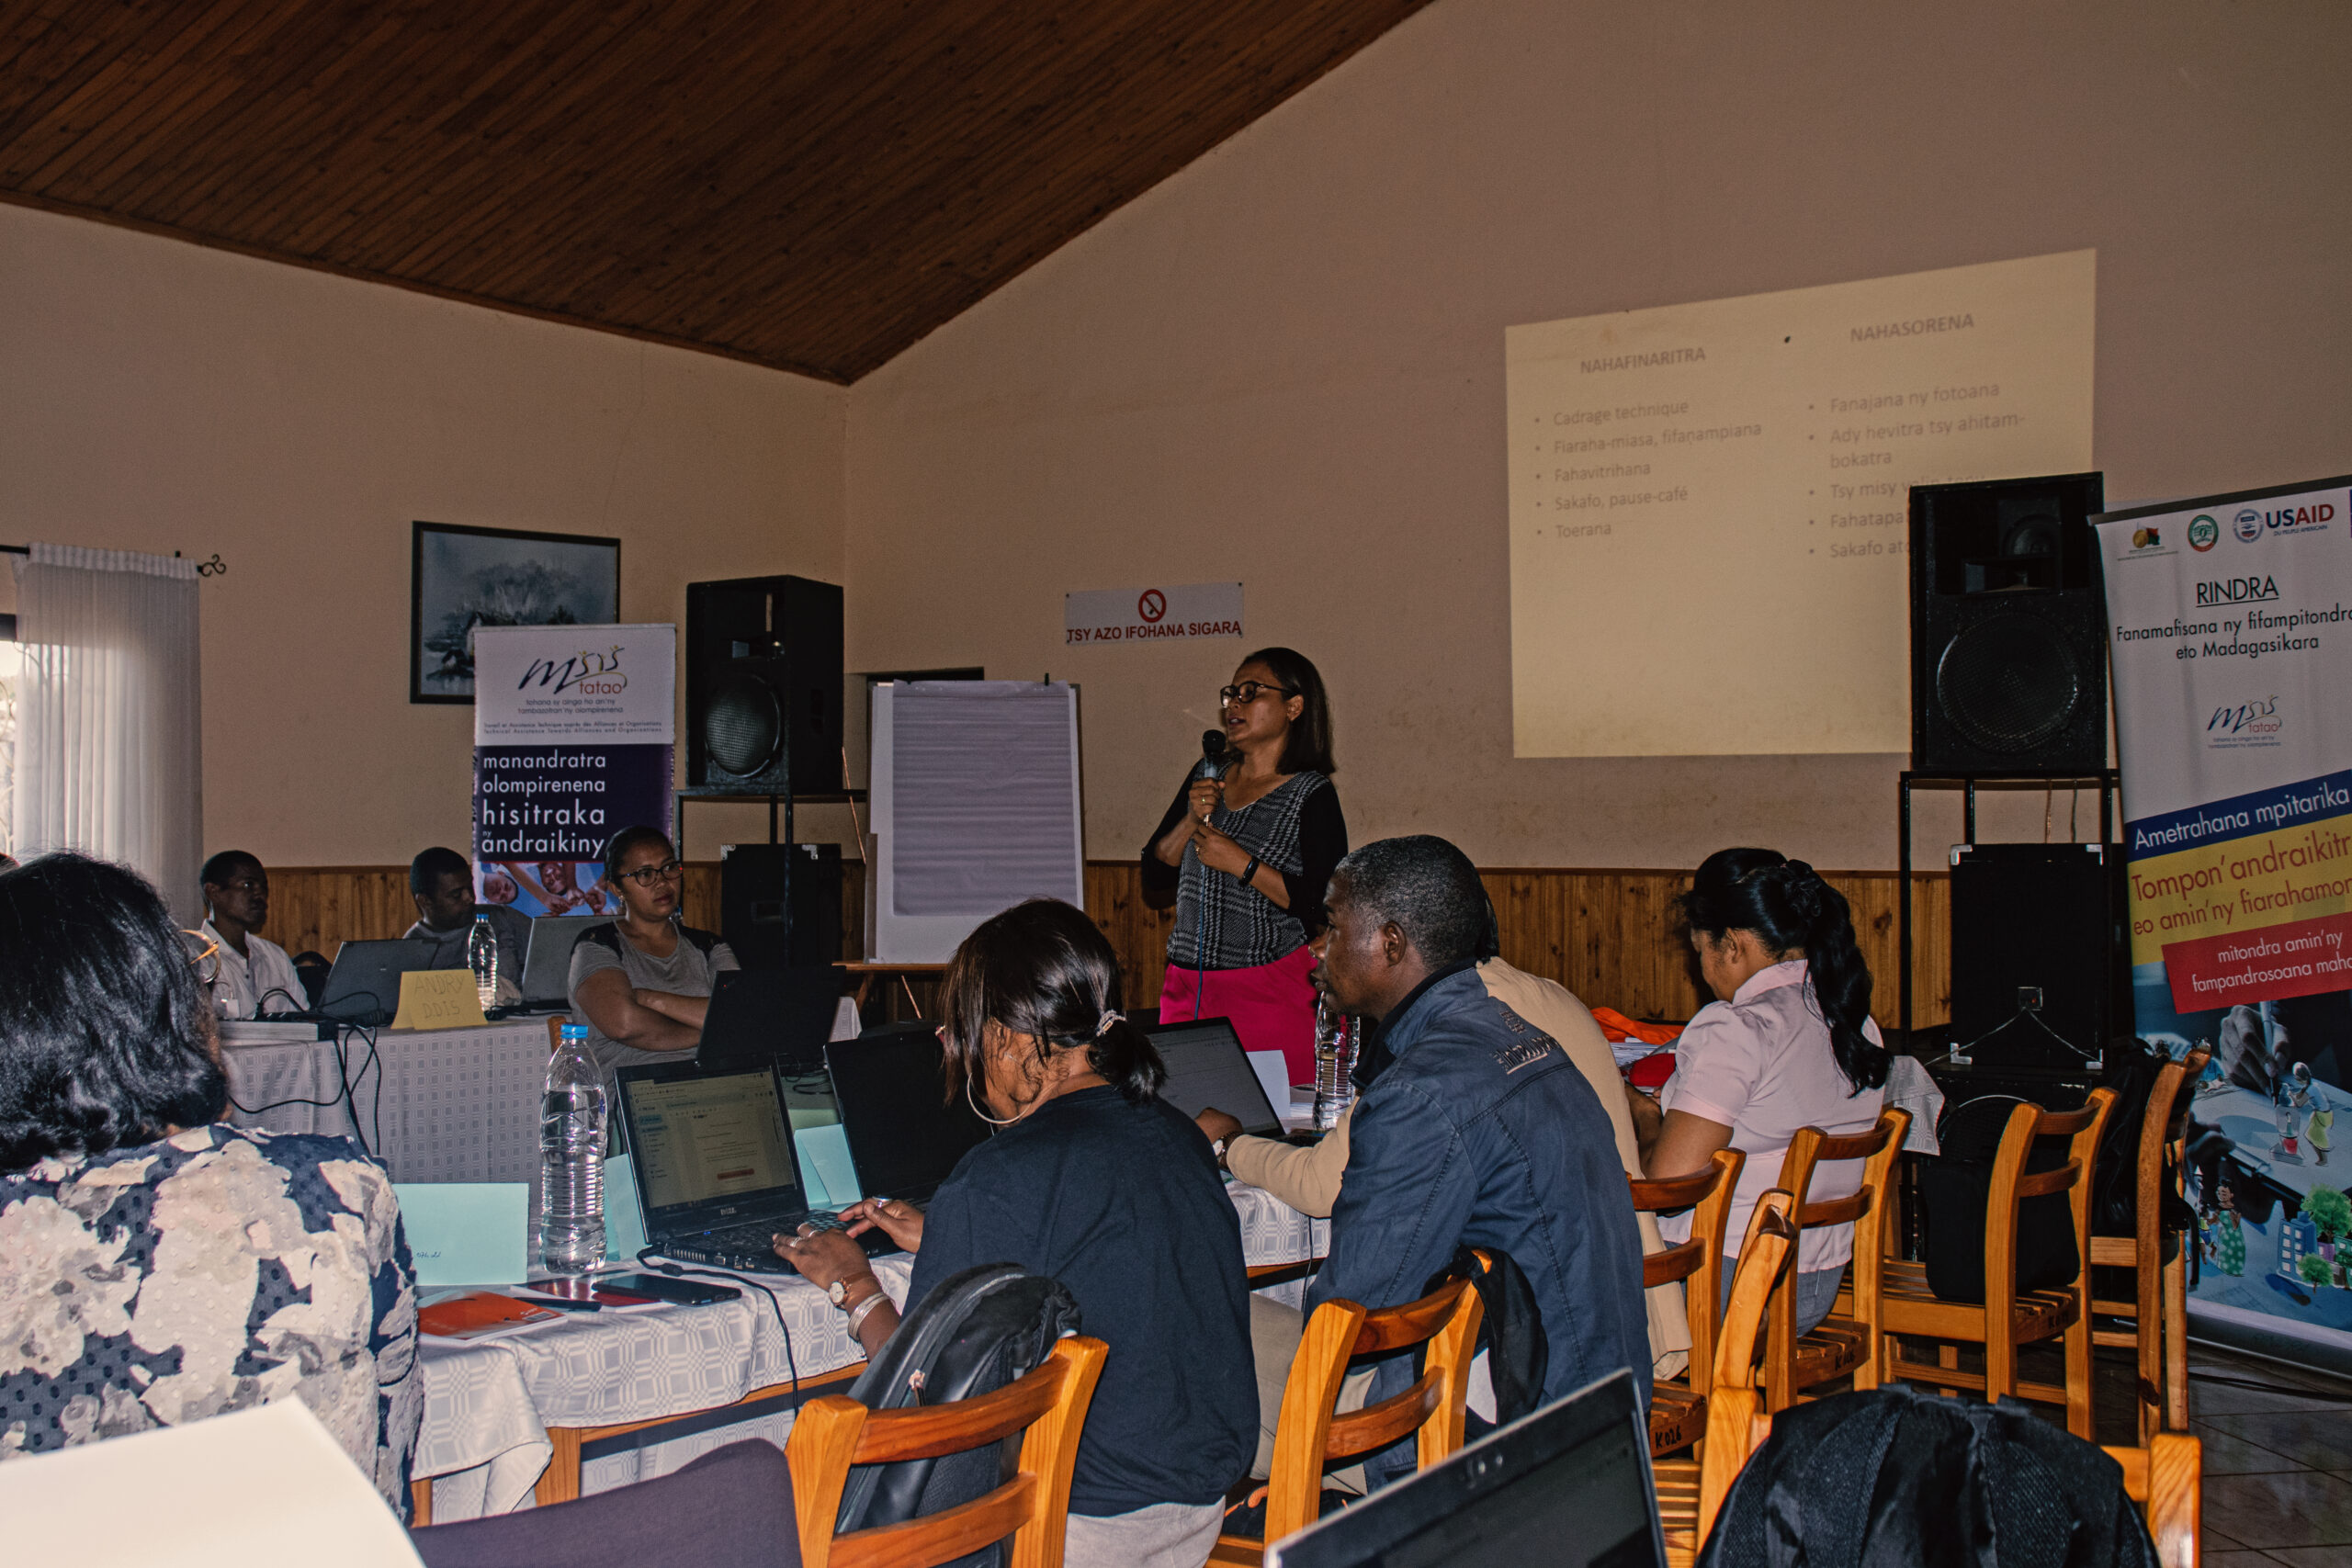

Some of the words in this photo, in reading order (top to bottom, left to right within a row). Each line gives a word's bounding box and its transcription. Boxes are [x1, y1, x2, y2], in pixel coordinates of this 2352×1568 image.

[1850, 313, 1974, 342] NAHASORENA
[1580, 347, 1706, 374] NAHAFINARITRA
[1830, 395, 1904, 413] Fanajana
[1908, 391, 1928, 405] ny
[1933, 383, 2000, 402] fotoana
[1554, 408, 1611, 426] Cadrage
[1615, 400, 1690, 419] technique
[1662, 423, 1762, 446] fifanampiana
[1830, 429, 1860, 445] Ady
[1866, 423, 1924, 441] hevitra
[1929, 420, 1953, 434] tsy
[1555, 462, 1651, 482] Fahavitrihana
[1830, 450, 1893, 469] bokatra
[1555, 494, 1605, 511] Sakafo,
[1609, 486, 1689, 509] pause-café
[1831, 484, 1855, 500] Tsy
[1859, 479, 1896, 497] misy
[1830, 510, 1906, 529] Fahatapa
[2266, 503, 2335, 529] USAID
[1555, 522, 1611, 538] Toerana
[1830, 540, 1883, 558] Sakafo
[2196, 575, 2279, 605] RINDRA
[1068, 628, 1091, 641] TSY
[1094, 626, 1122, 640] AZO
[1125, 624, 1185, 638] IFOHANA
[1189, 620, 1240, 636] SIGARA
[2116, 618, 2218, 642] Fanamafisana
[2223, 618, 2242, 637] ny
[2176, 643, 2197, 660] eto
[2202, 632, 2320, 659] Madagasikara
[579, 681, 623, 694] tatao
[2248, 722, 2278, 733] tatao
[483, 749, 606, 770] manandratra
[482, 773, 606, 796] olompirenena
[482, 798, 605, 826] hisitraka
[2134, 811, 2250, 852] Ametrahana
[2256, 782, 2350, 827] mpitarika
[481, 829, 605, 860] andraikiny
[2133, 919, 2154, 935] eo
[2160, 900, 2233, 931] amin'ny
[2218, 936, 2281, 964] mitondra
[2285, 930, 2343, 953] amin'ny
[2192, 962, 2312, 994] fampandrosoana
